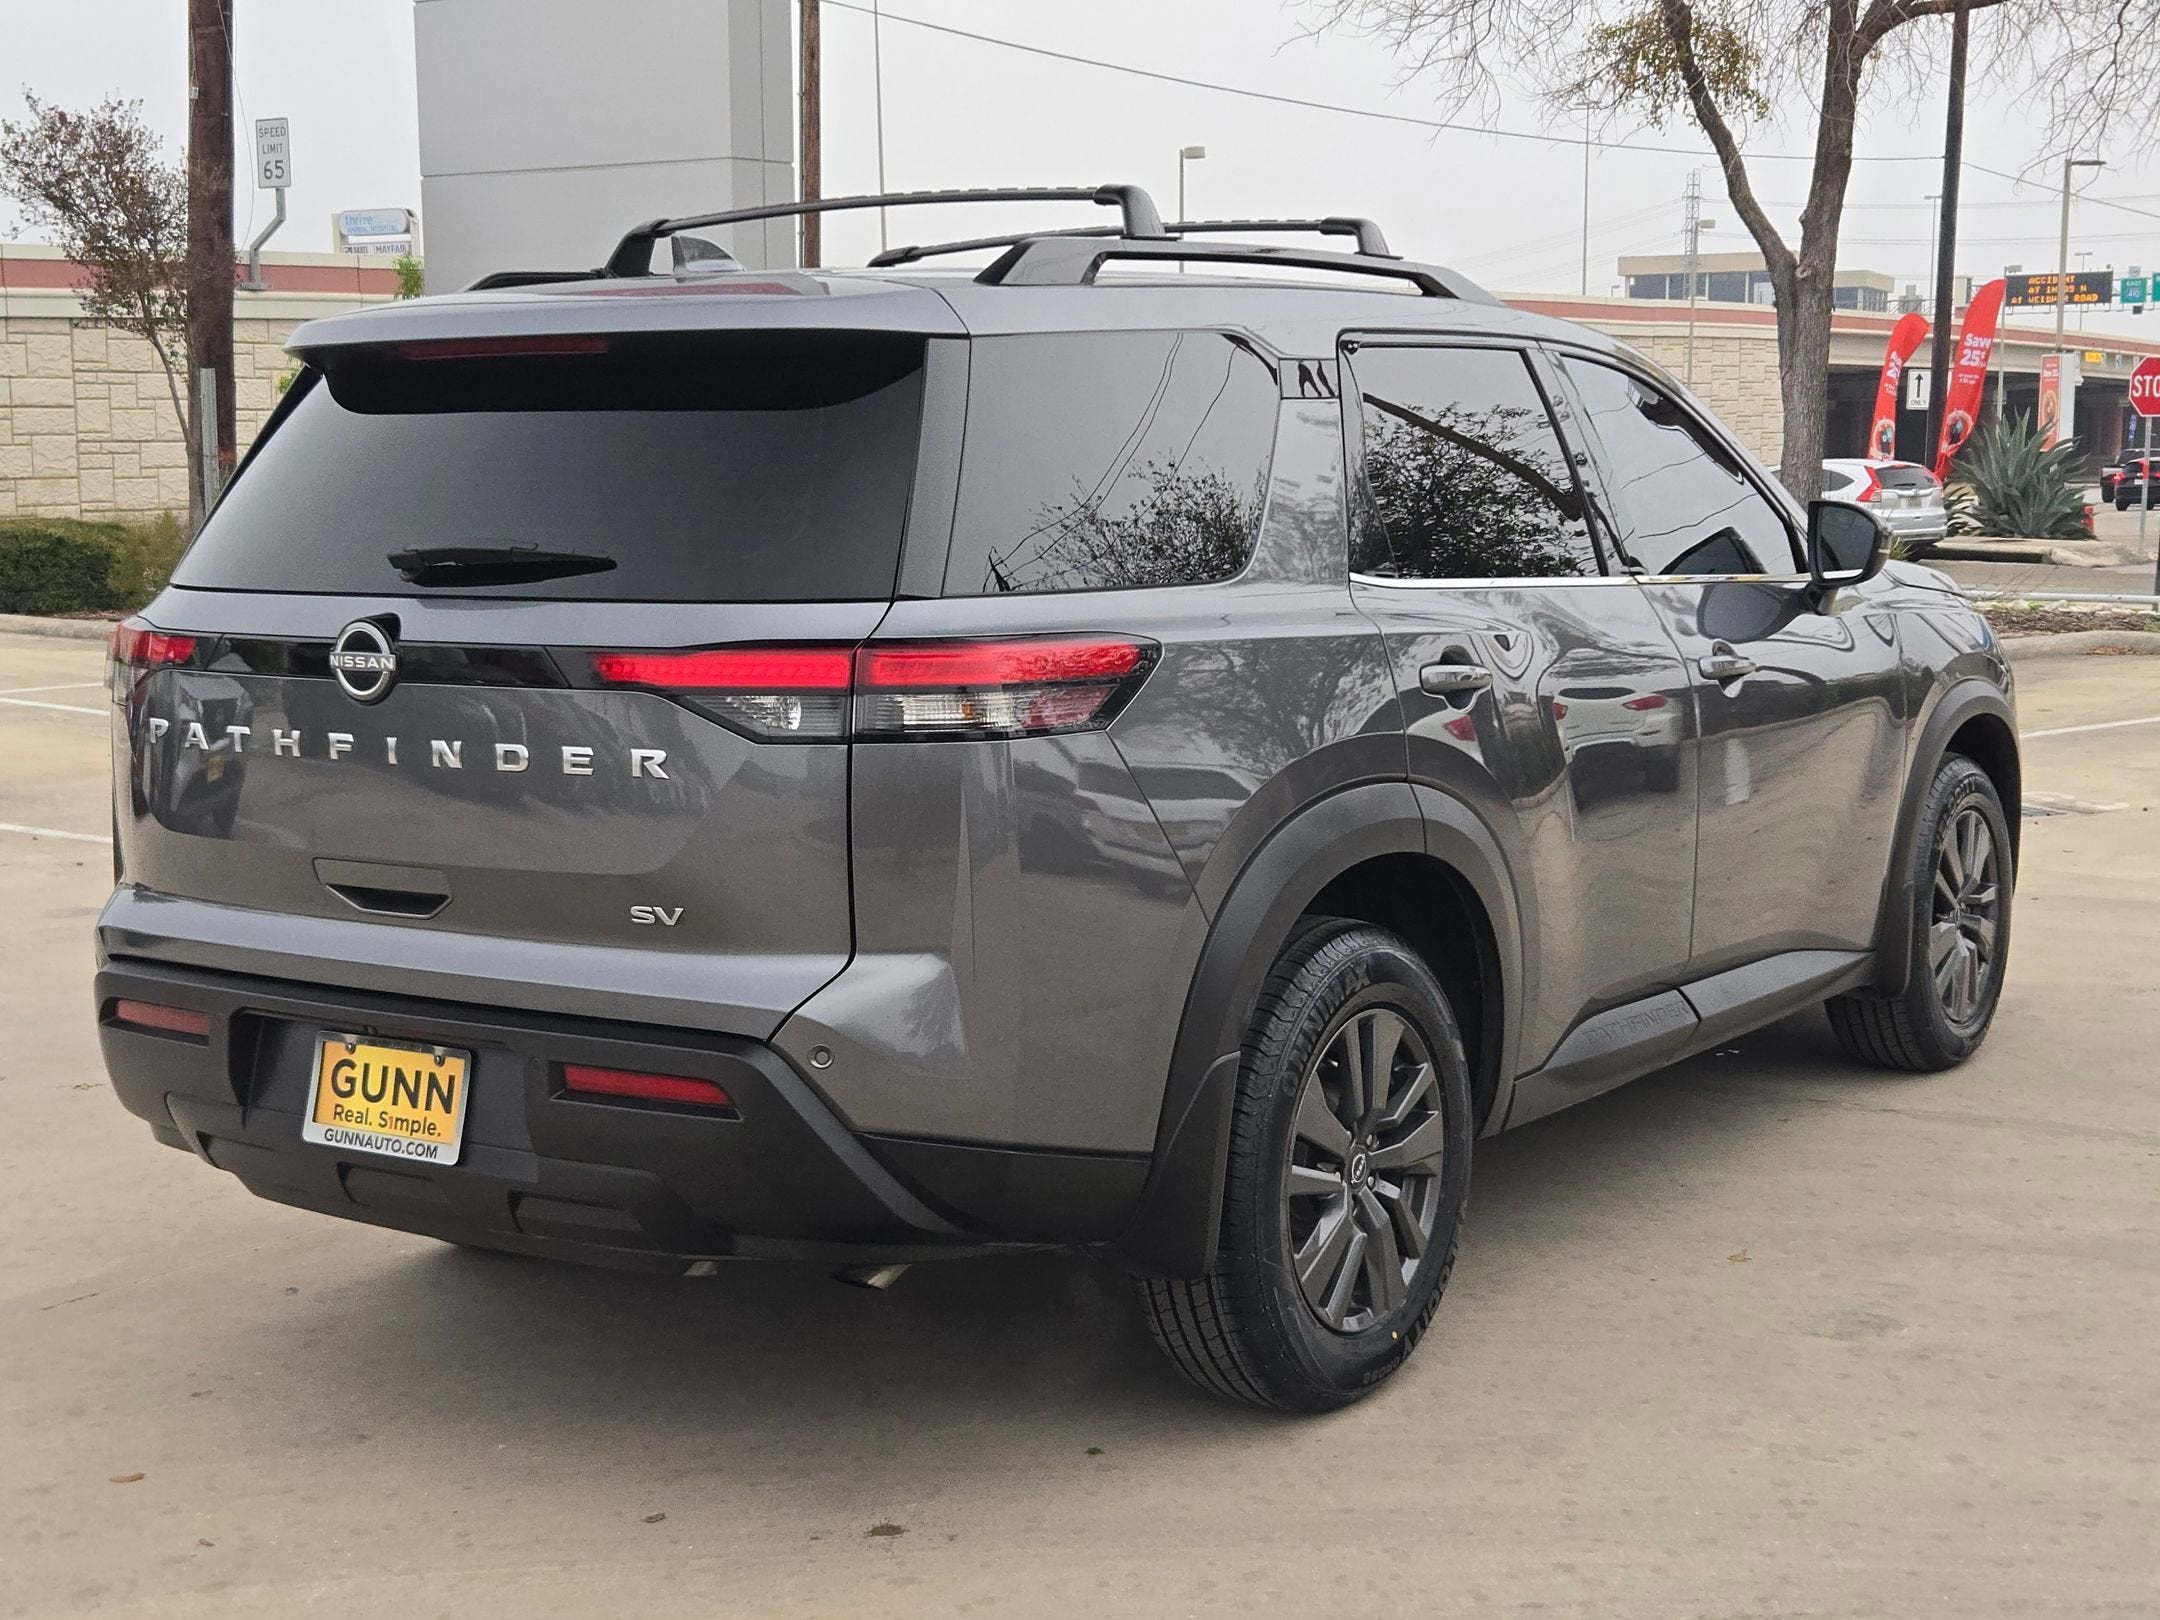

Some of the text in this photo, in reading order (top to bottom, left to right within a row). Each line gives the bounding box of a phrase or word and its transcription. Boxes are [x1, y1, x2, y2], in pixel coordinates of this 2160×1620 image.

[258, 126, 287, 138] SPEED
[262, 143, 284, 155] LIMIT
[263, 159, 285, 180] 65
[344, 214, 374, 226] thrive
[2028, 275, 2076, 285] ACCIDNT
[2010, 293, 2099, 305] AT WEIDNR ROAD
[2028, 286, 2041, 294] AT
[1964, 332, 1992, 349] Save
[2132, 375, 2160, 398] STO
[331, 653, 394, 669] NISSAN
[149, 717, 670, 780] PATHFINDER
[630, 905, 685, 926] SV
[1582, 1001, 1690, 1041] PATHFINDER
[331, 1058, 456, 1115] GUNN
[333, 1103, 373, 1127] Real.
[323, 1128, 439, 1160] GUNNAUTO.COM
